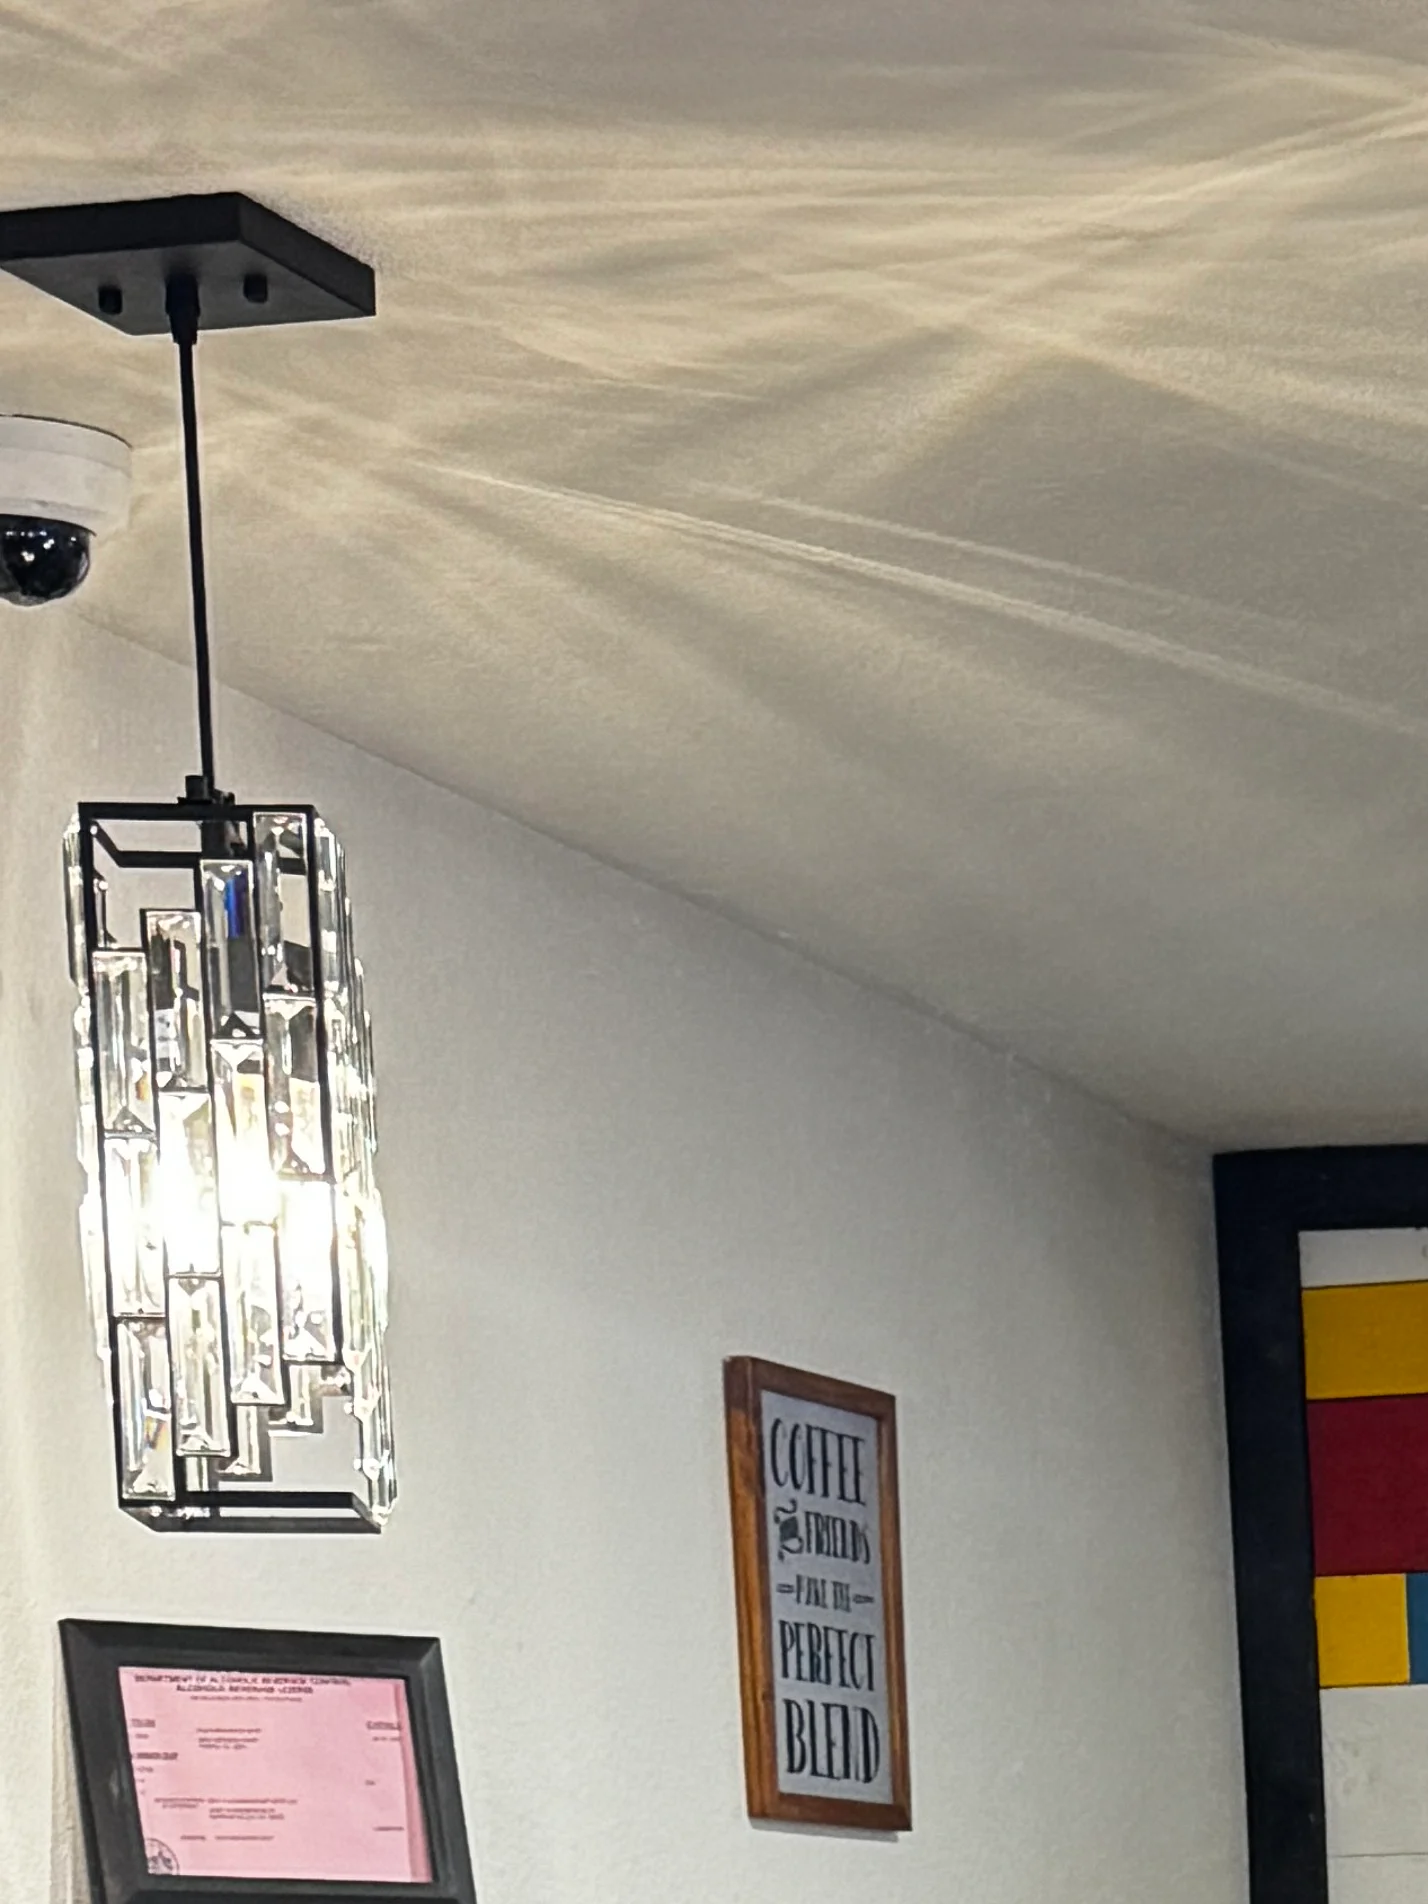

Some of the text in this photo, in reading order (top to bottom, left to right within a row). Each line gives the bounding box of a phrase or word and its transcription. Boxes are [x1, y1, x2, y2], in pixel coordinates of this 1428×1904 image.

[770, 1417, 866, 1506] COFFEE
[779, 1620, 875, 1691] PERFECT
[783, 1698, 881, 1784] BLEND
